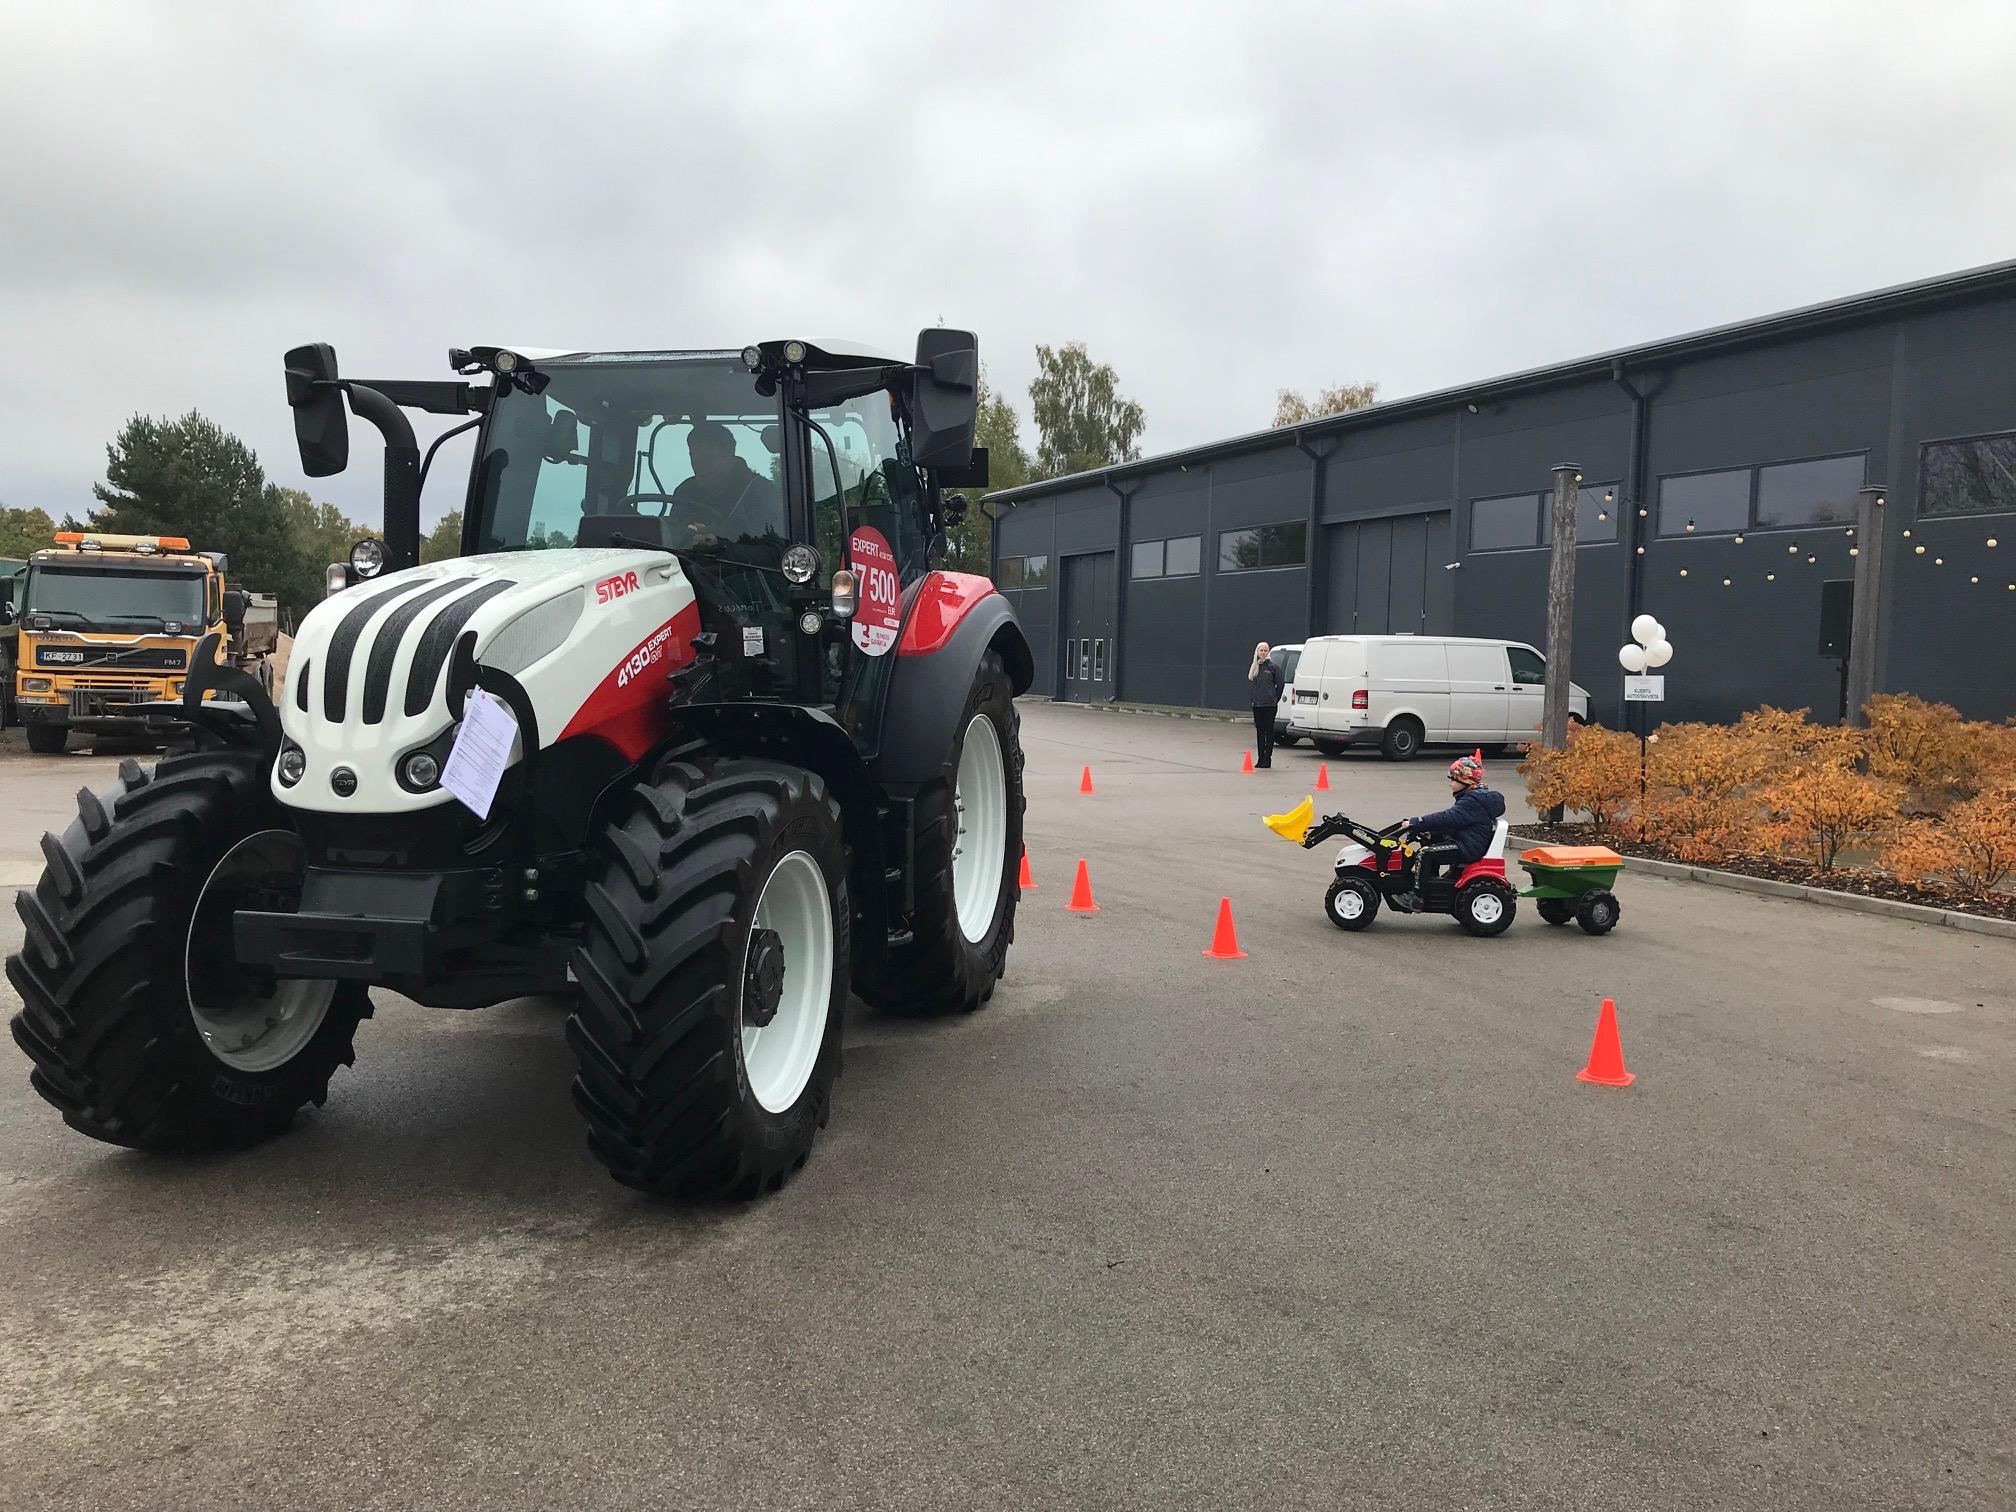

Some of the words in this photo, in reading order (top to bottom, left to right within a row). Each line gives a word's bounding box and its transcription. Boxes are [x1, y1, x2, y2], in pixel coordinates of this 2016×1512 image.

[852, 537, 879, 557] EXPERT
[595, 571, 640, 604] STEYR
[870, 567, 896, 606] 500
[648, 626, 673, 651] EXPERT
[617, 646, 650, 689] 4130
